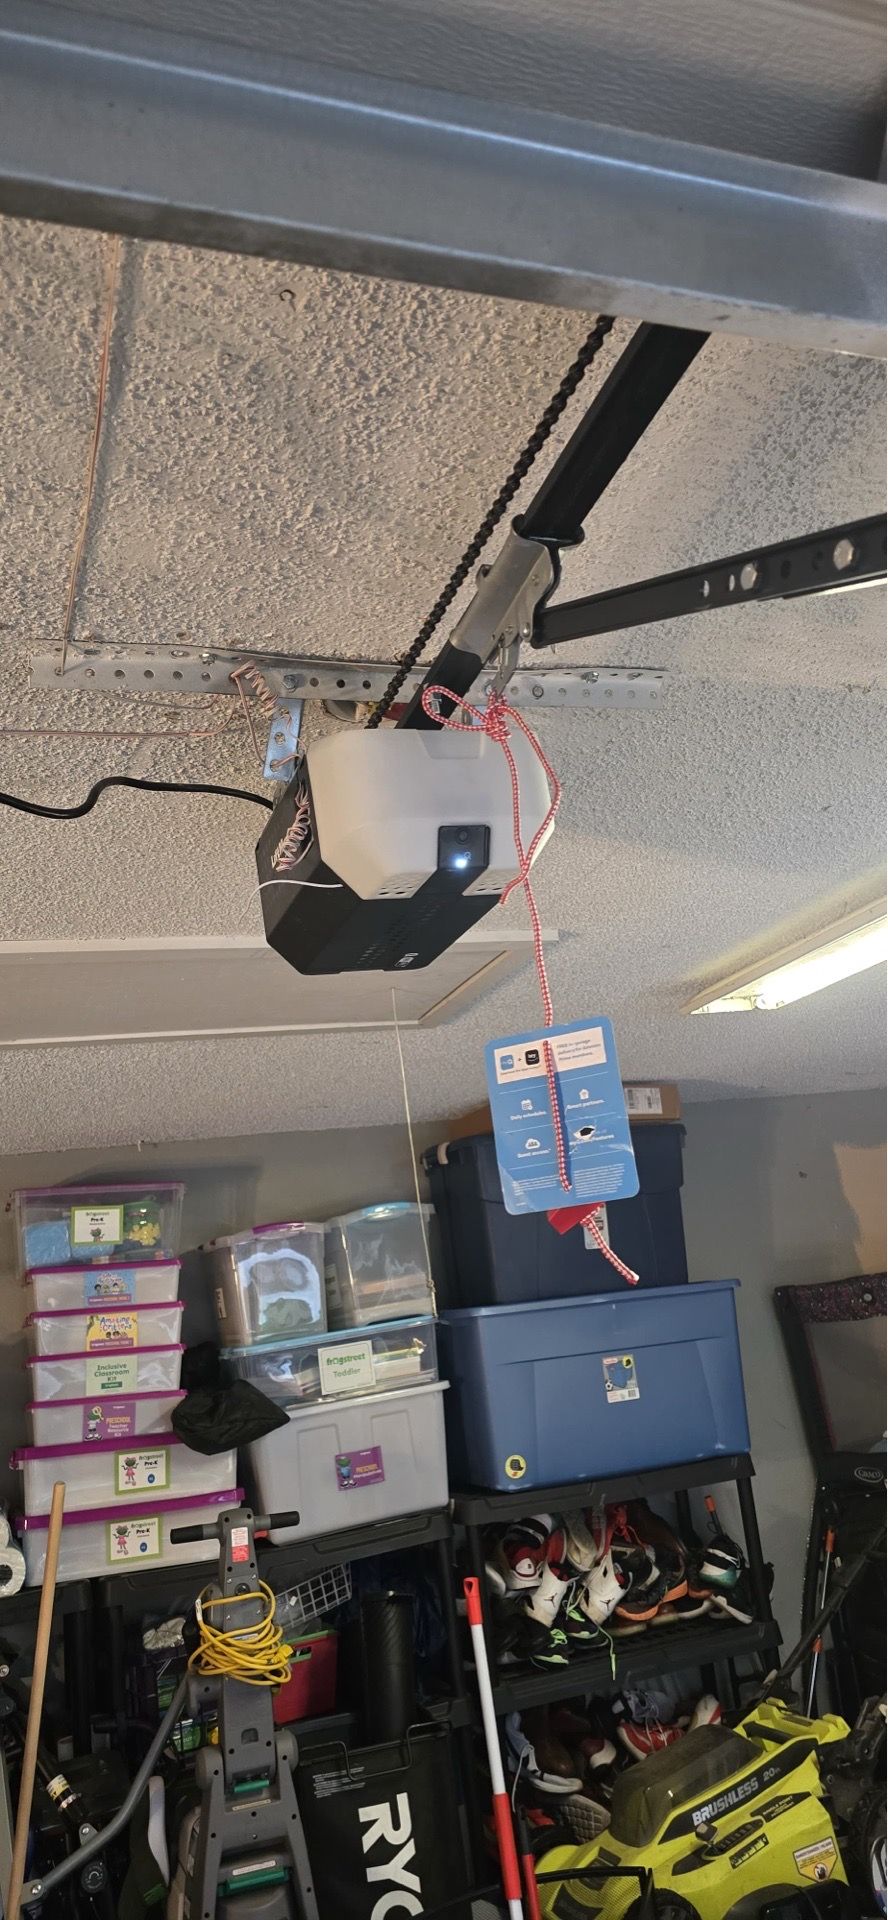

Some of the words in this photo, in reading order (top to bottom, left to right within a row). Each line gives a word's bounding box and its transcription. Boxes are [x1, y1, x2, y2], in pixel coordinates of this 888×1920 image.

[100, 1316, 130, 1325] Amazing
[332, 1368, 360, 1377] Toddler
[692, 1777, 758, 1826] BRUSHLESS
